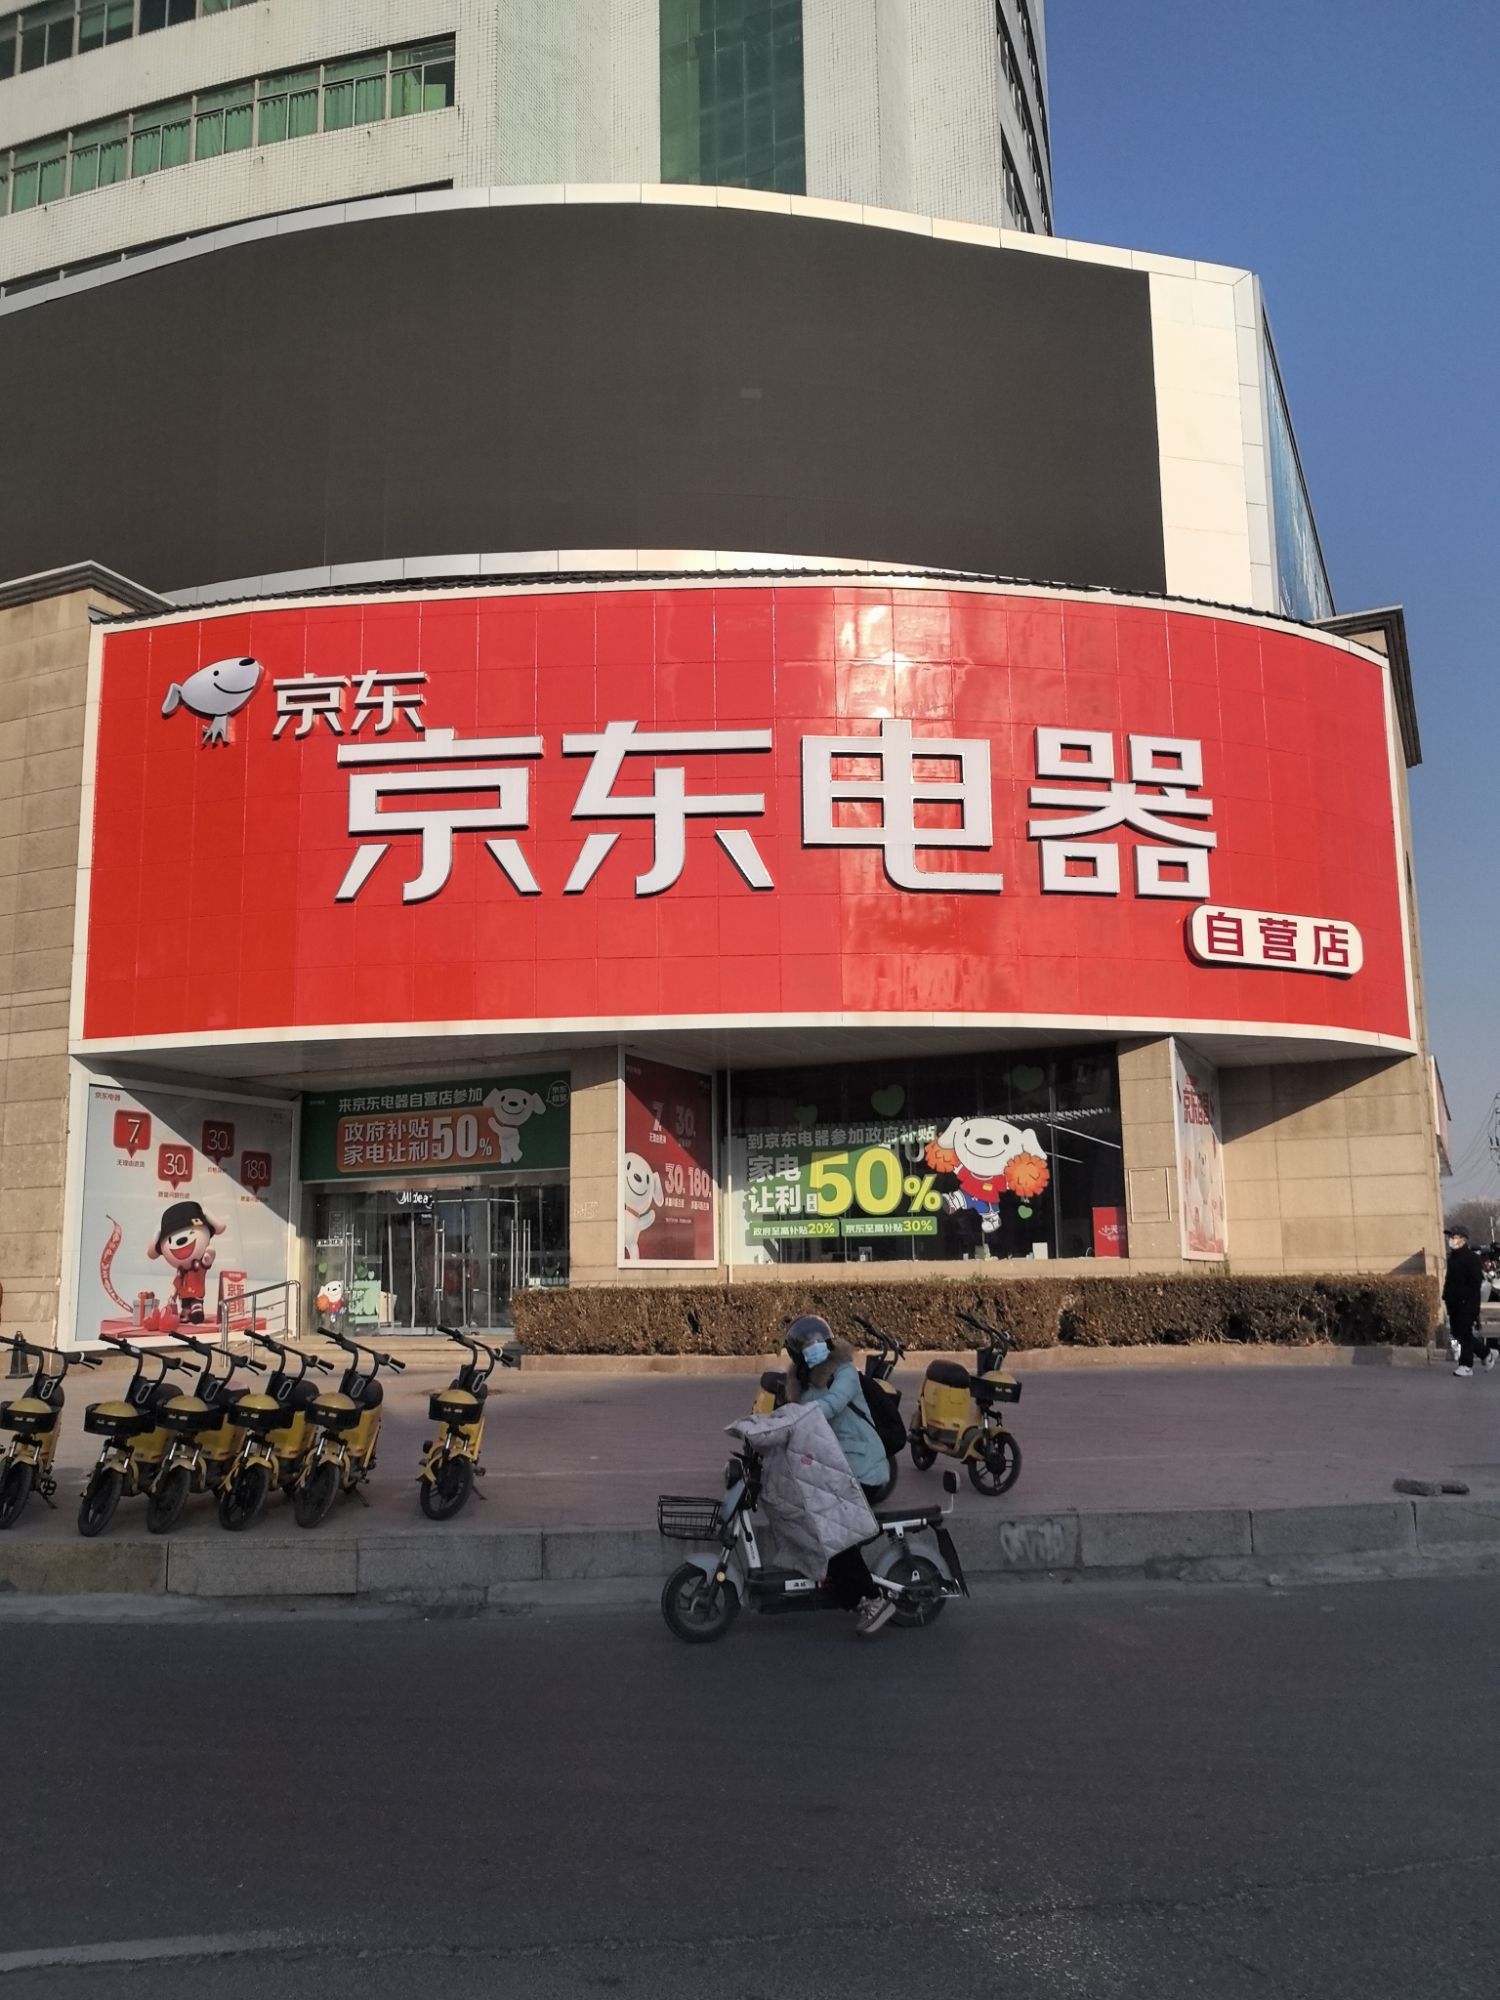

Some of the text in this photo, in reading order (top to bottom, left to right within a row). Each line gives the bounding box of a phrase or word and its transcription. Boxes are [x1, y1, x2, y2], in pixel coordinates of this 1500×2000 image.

[272, 670, 428, 738] 京东
[335, 719, 1217, 904] 京东电器
[1206, 911, 1350, 968] 自营店
[338, 1087, 483, 1113] 来京东电器自营店参加
[344, 1117, 430, 1143] 政府补贴
[431, 1113, 493, 1160] 50%
[747, 1124, 936, 1150] 到京东电器参加政府补贴
[343, 1140, 429, 1166] 家电让利
[748, 1154, 801, 1183] 家电
[809, 1147, 942, 1216] 50%
[749, 1185, 801, 1214] 让利
[753, 1222, 835, 1236] 政府至高补贴20%
[845, 1220, 933, 1234] 京东至高补贴30%
